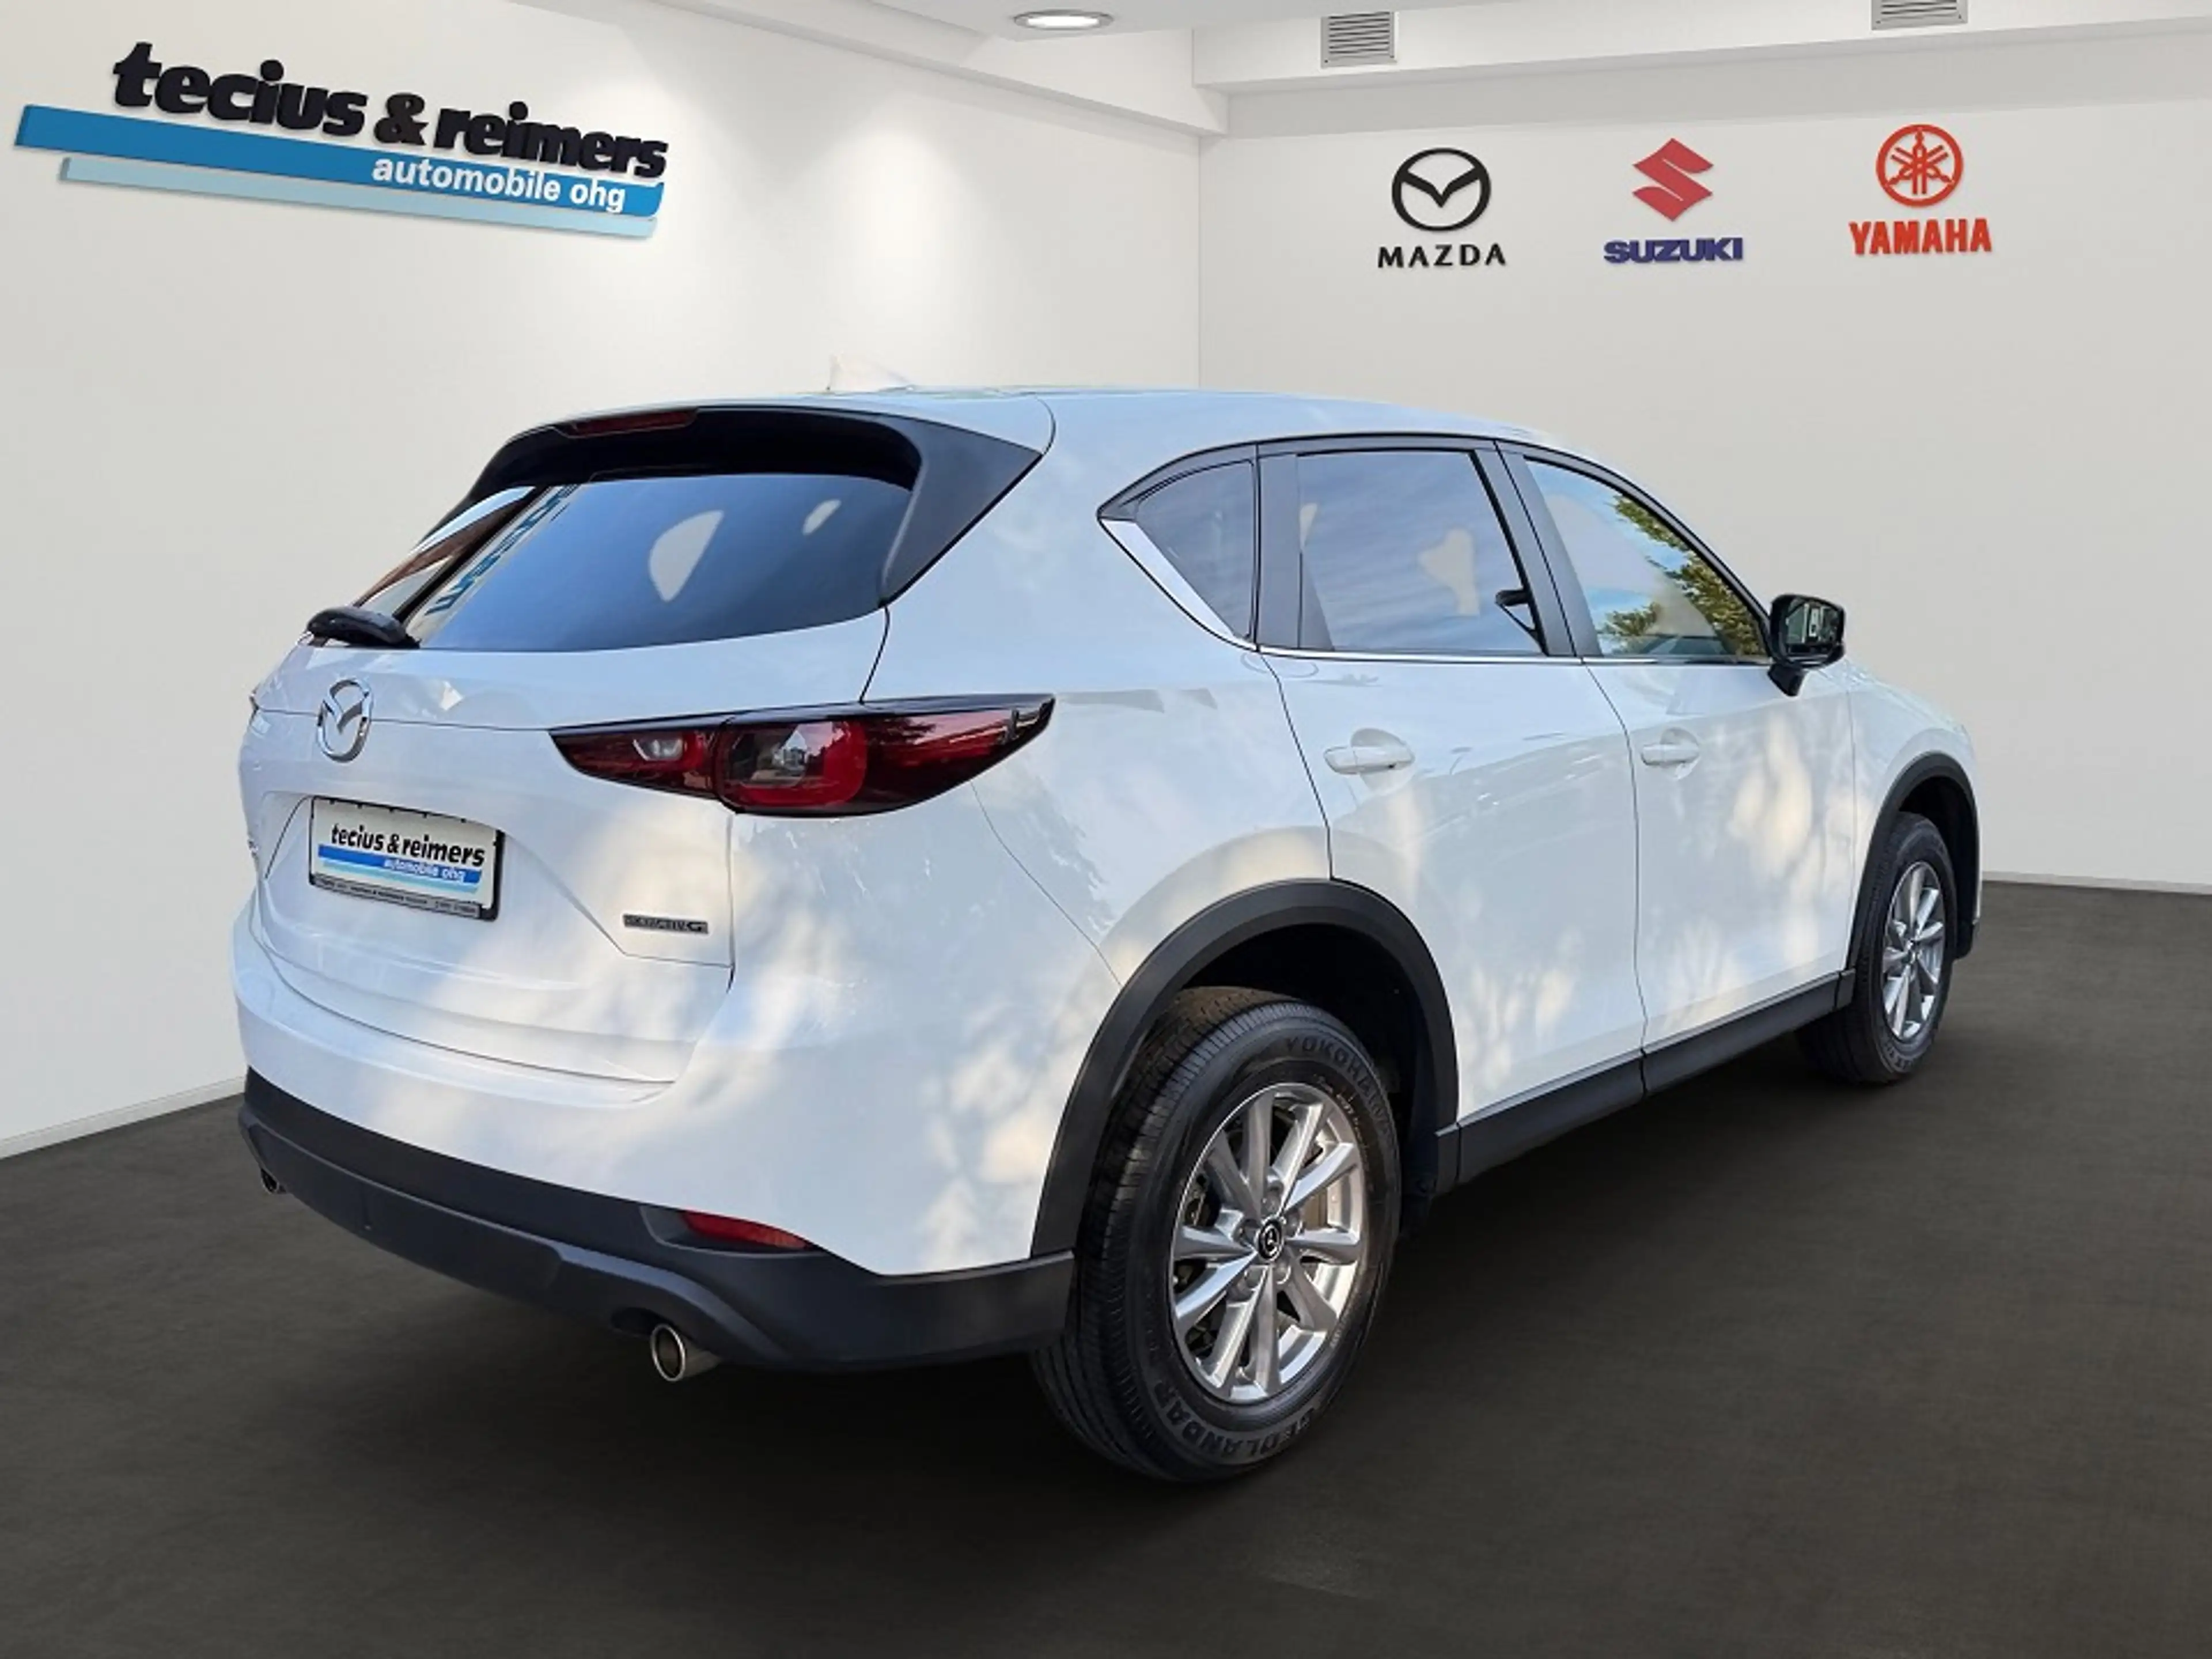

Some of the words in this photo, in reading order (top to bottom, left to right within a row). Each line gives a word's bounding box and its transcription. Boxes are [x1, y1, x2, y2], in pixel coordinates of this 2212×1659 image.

[111, 41, 368, 137] tecius
[373, 92, 428, 146] &
[433, 100, 668, 179] reimers
[372, 154, 561, 203] automobile
[569, 181, 626, 214] ohg
[1378, 243, 1507, 268] MAZDA
[1604, 237, 1744, 265] SUZUKI
[1850, 218, 1993, 256] YAMAHA
[331, 824, 384, 850] tecius
[387, 834, 400, 854] &
[403, 835, 486, 867] reimers
